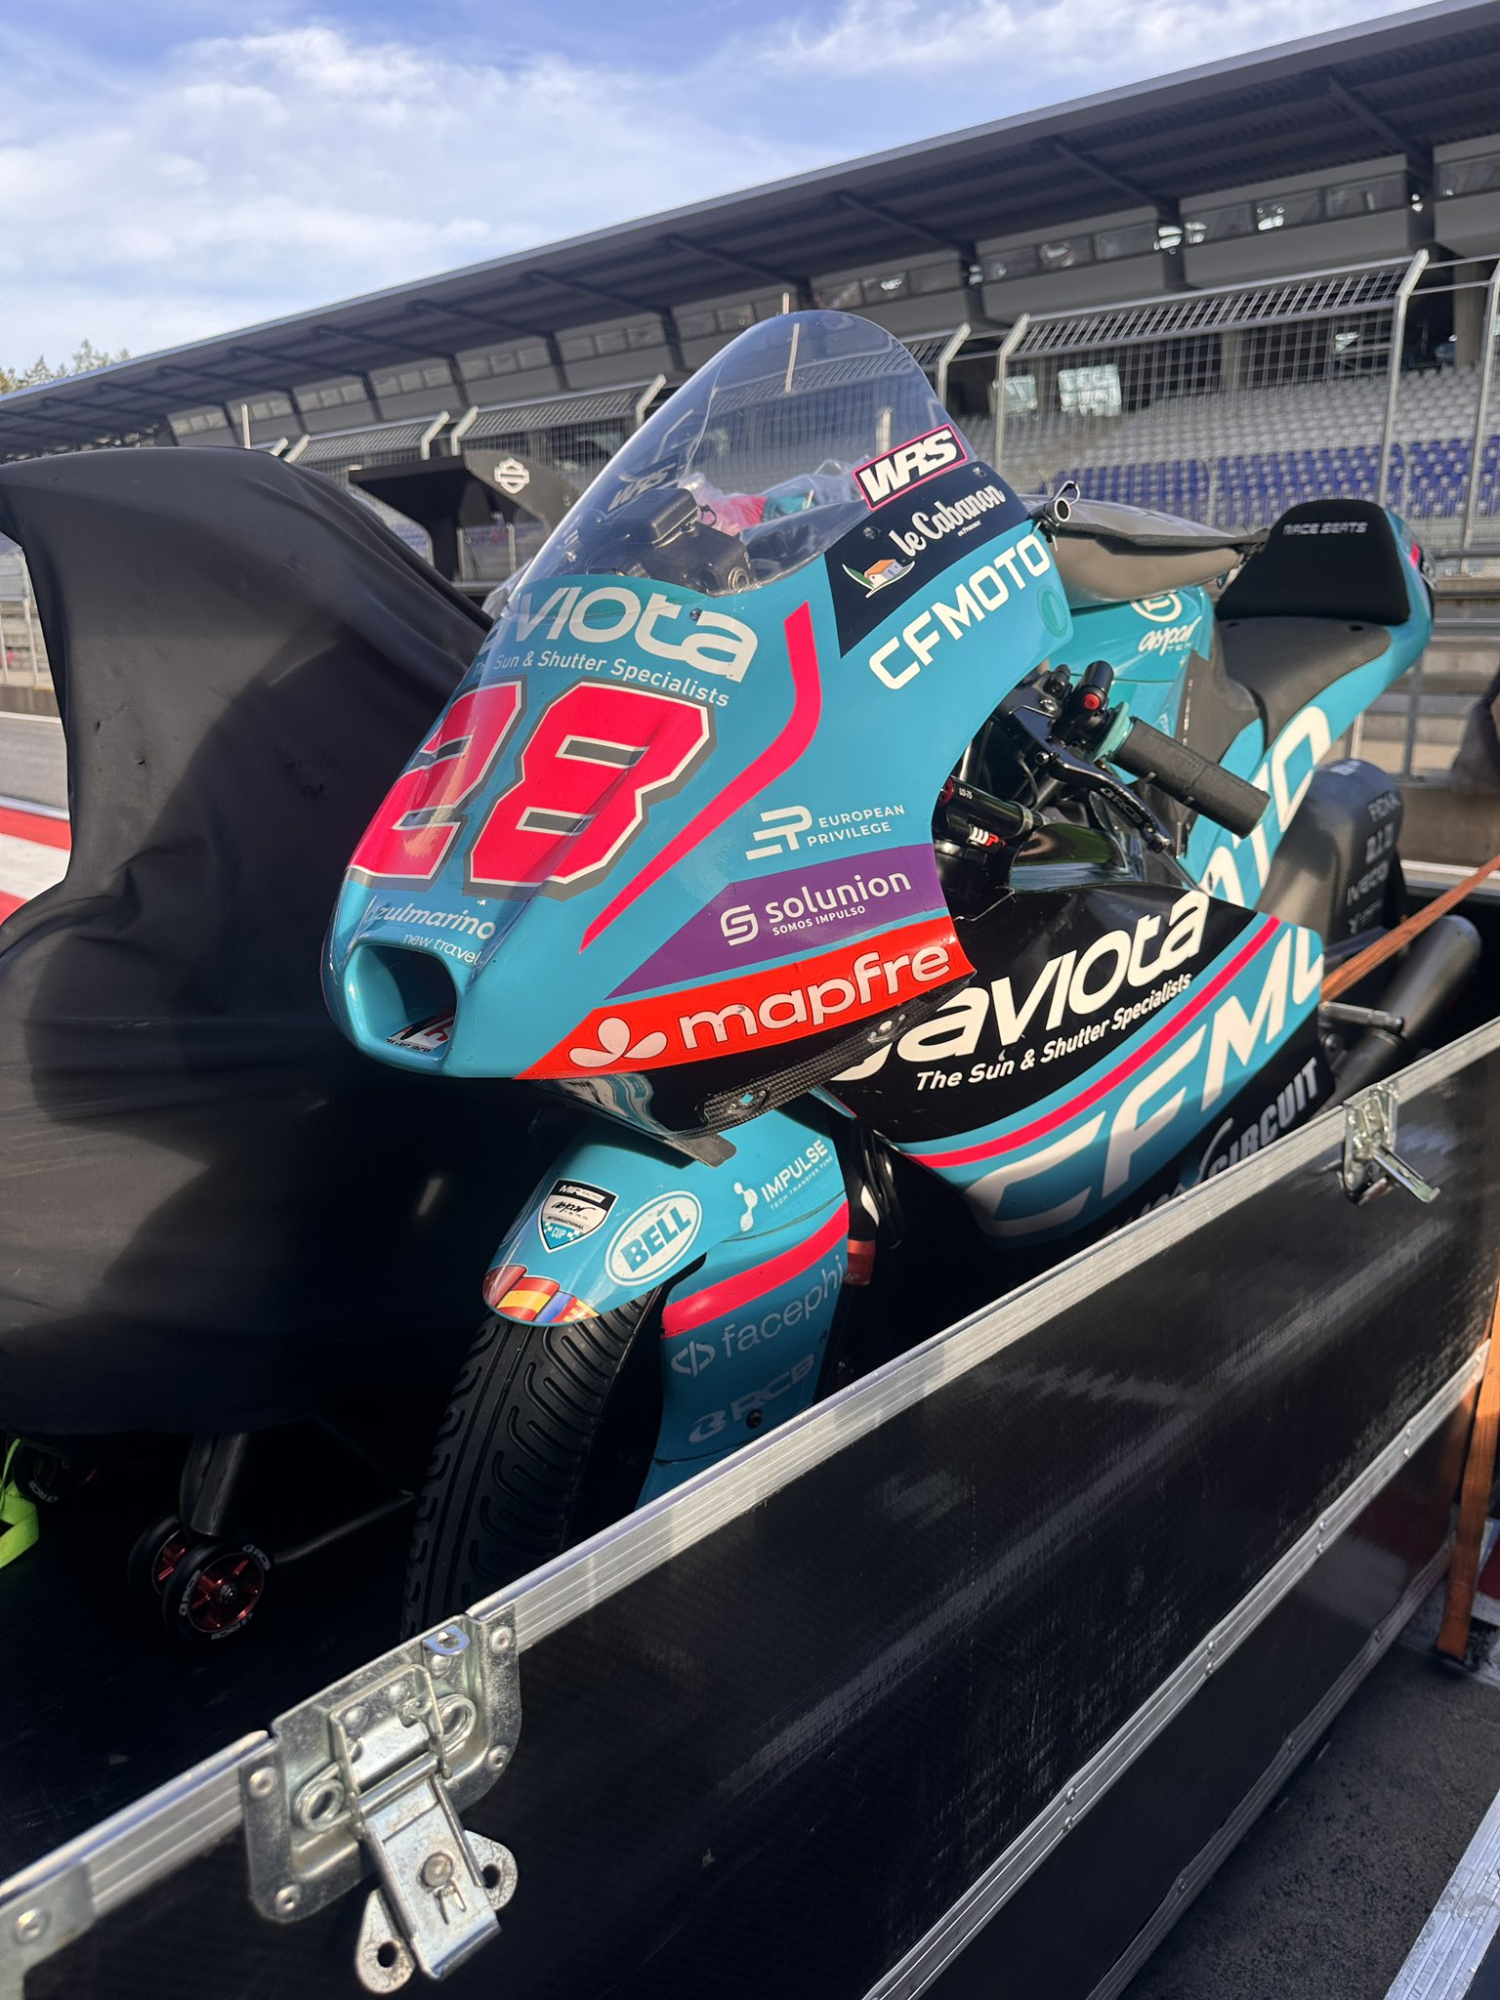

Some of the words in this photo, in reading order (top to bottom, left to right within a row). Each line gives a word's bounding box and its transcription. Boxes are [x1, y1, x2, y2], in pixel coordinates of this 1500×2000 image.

[859, 430, 957, 502] WRS
[911, 485, 1007, 541] Cabanon
[869, 534, 1051, 690] CFMOTO
[493, 654, 519, 670] Sun
[523, 652, 532, 668] &
[538, 650, 607, 673] Shutter
[610, 658, 729, 707] Specialists
[345, 677, 715, 895] 28
[819, 804, 906, 828] EUROPEAN
[807, 821, 891, 847] PRIVILEGE
[765, 872, 912, 924] solunion
[772, 918, 813, 936] SOMOS
[815, 905, 866, 926] IMPULSO
[403, 933, 431, 947] new
[434, 938, 482, 966] travel
[679, 945, 951, 1050] mapfre
[915, 1068, 963, 1091] The
[968, 1055, 1015, 1083] Sun
[1019, 1048, 1036, 1071] &
[1039, 1019, 1110, 1064] Shutter
[1111, 971, 1193, 1030] Specialists
[761, 1140, 829, 1203] IMPULSE
[551, 1227, 567, 1239] CUP
[620, 1207, 692, 1273] BELL
[722, 1255, 843, 1358] facephi
